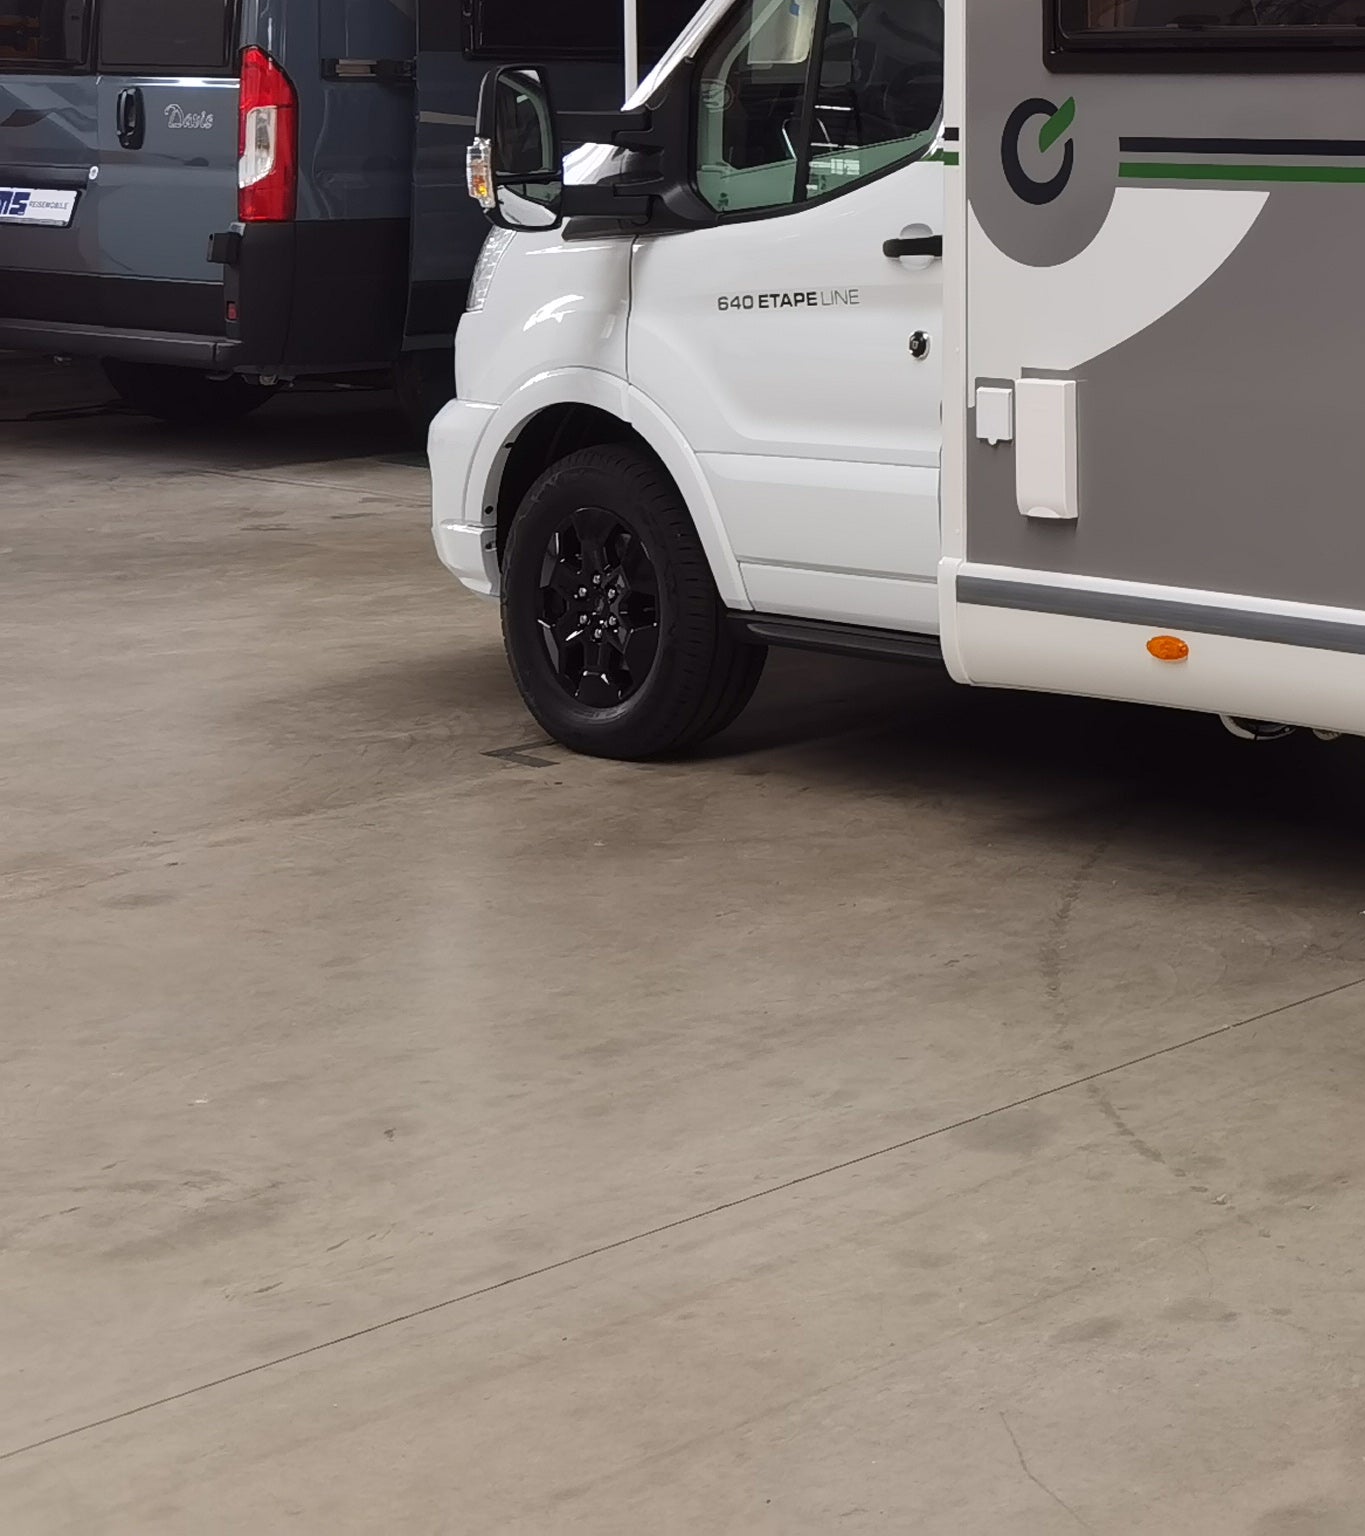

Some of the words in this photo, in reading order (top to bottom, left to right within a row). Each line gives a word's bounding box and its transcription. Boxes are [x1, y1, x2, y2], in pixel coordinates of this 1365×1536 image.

[164, 103, 214, 129] Davis
[717, 295, 754, 311] 640
[758, 292, 818, 309] ETAPE
[821, 289, 861, 306] LINE
